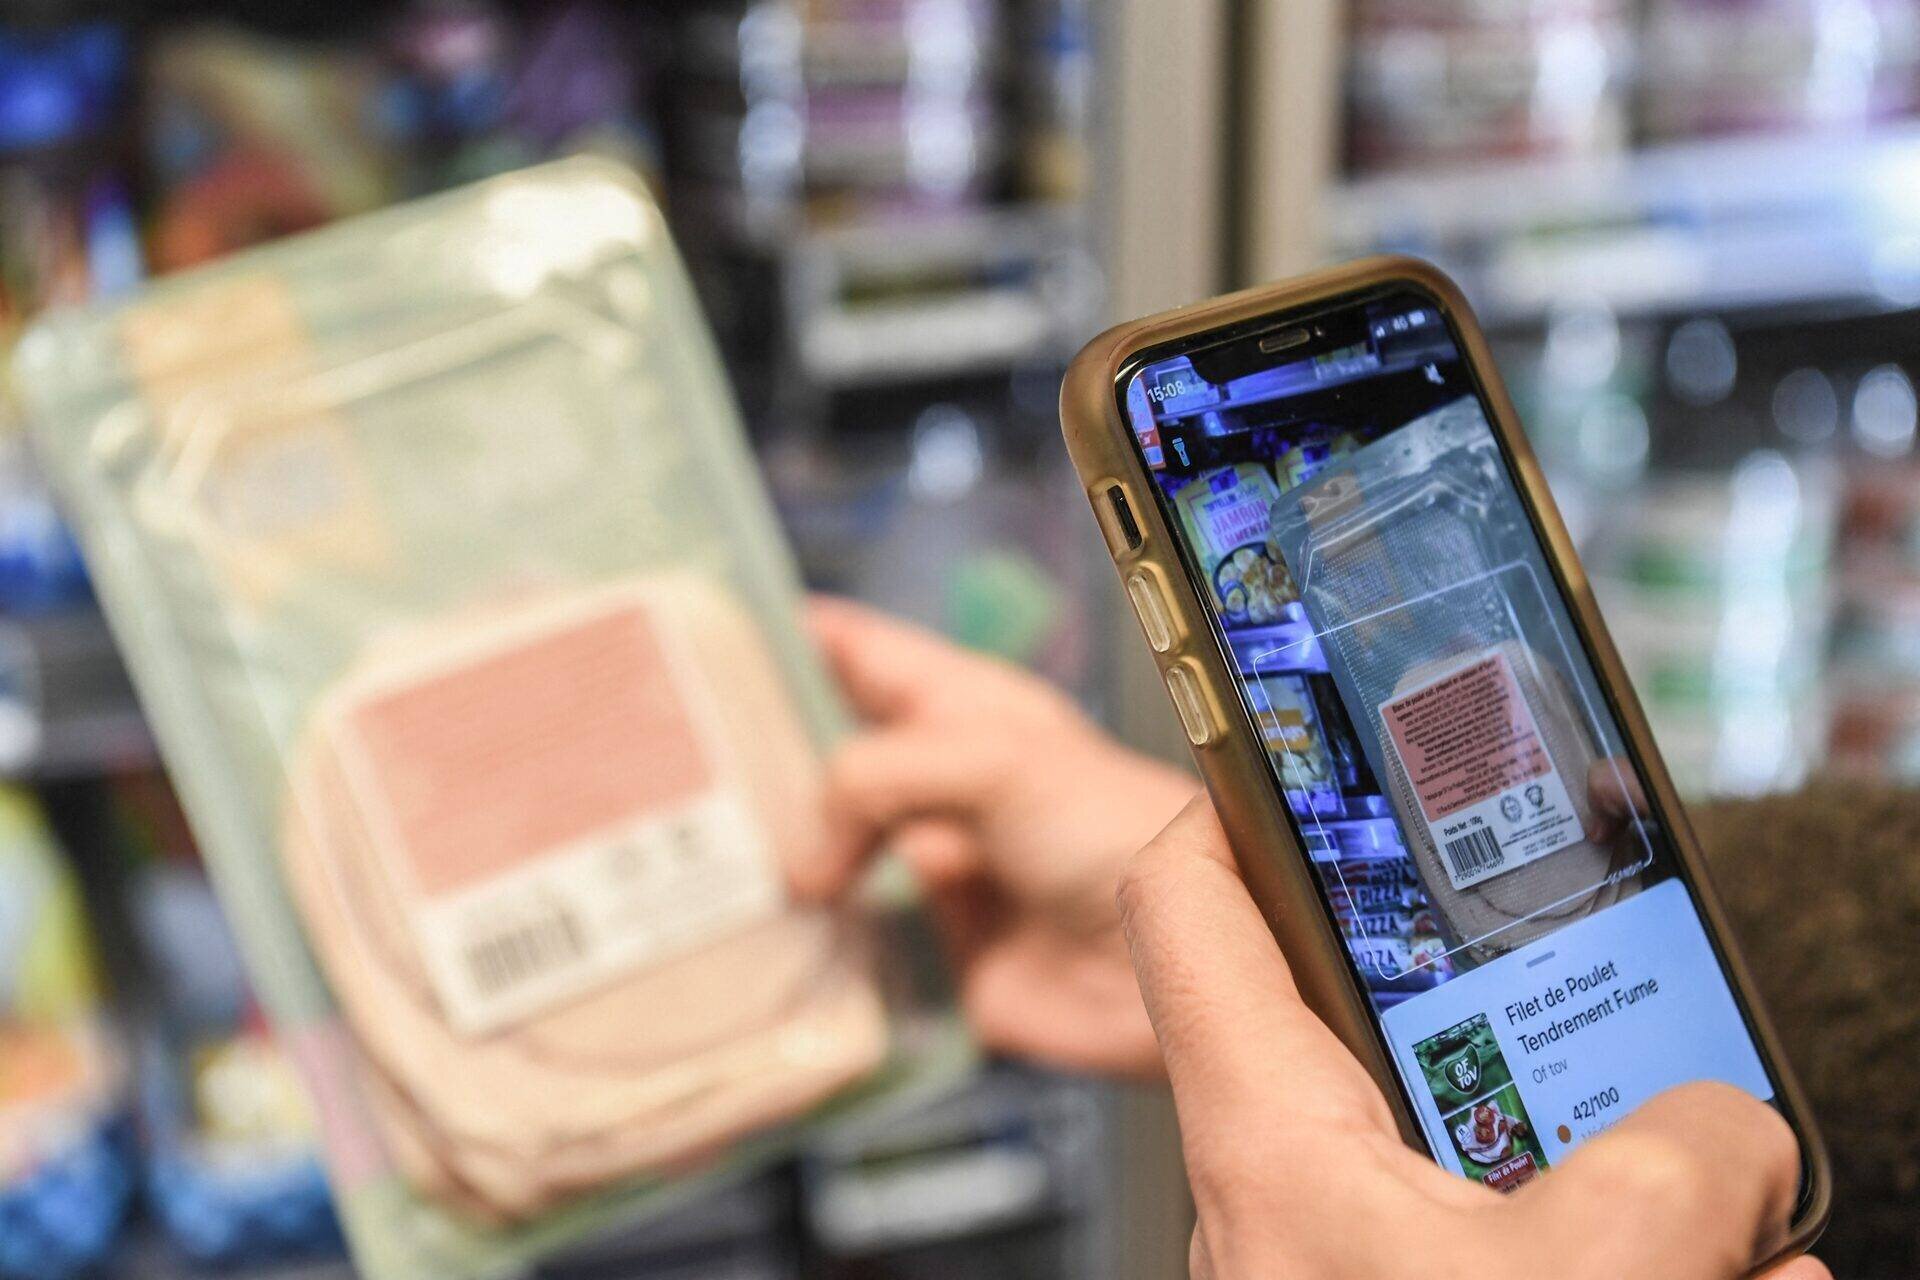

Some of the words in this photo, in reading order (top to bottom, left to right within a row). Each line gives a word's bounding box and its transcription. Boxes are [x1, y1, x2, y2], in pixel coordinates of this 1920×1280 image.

[1147, 380, 1186, 404] 15:08
[1213, 499, 1269, 536] JAMBON
[1360, 884, 1403, 906] PIZZA
[1505, 998, 1543, 1025] Filet
[1544, 987, 1566, 1008] de
[1565, 960, 1618, 997] Poulet
[1517, 997, 1614, 1055] Tendrement
[1454, 1058, 1470, 1077] OF
[1457, 1065, 1478, 1090] TOV
[1532, 1064, 1549, 1084] Of
[1549, 1056, 1568, 1077] tov
[1573, 1086, 1620, 1121] 42/100
